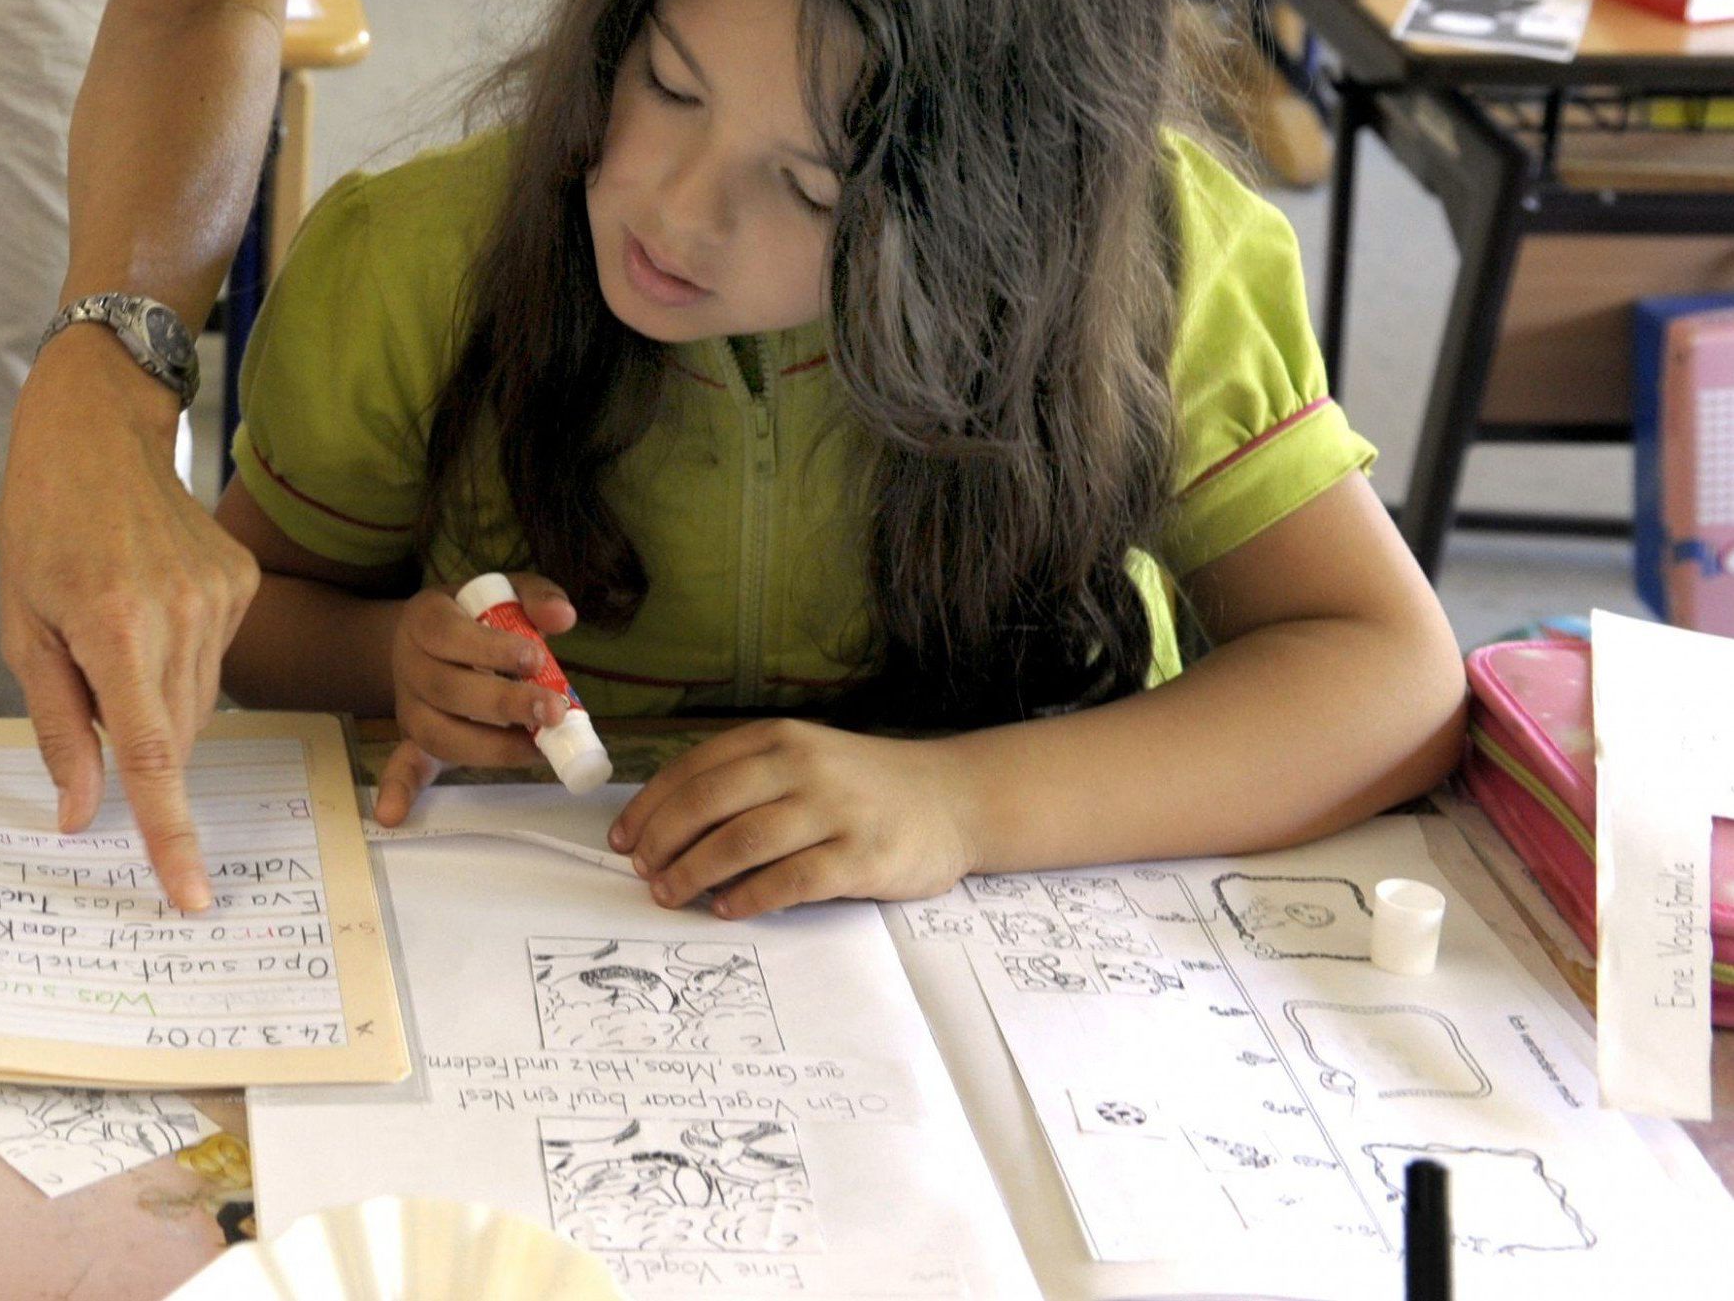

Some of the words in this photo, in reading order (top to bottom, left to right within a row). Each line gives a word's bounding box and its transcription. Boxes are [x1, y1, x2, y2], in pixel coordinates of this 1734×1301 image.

[21, 834, 48, 848] die
[36, 866, 90, 887] das
[207, 858, 314, 883] Vater
[74, 896, 135, 917] das
[251, 889, 321, 916] Eva
[102, 928, 195, 951] sucht
[211, 924, 324, 946] Harro
[137, 958, 237, 984] sucht
[258, 953, 329, 980] Opa
[77, 988, 157, 1017] Was
[514, 1056, 559, 1080] und
[571, 1059, 635, 1083] Holz
[804, 1061, 846, 1080] aus
[456, 1088, 515, 1112] Nest
[522, 1087, 559, 1106] ein
[568, 1091, 627, 1114] baut
[642, 1088, 800, 1120] Vogelpaar
[805, 1097, 857, 1119] Ein
[737, 1261, 803, 1290] Eine
